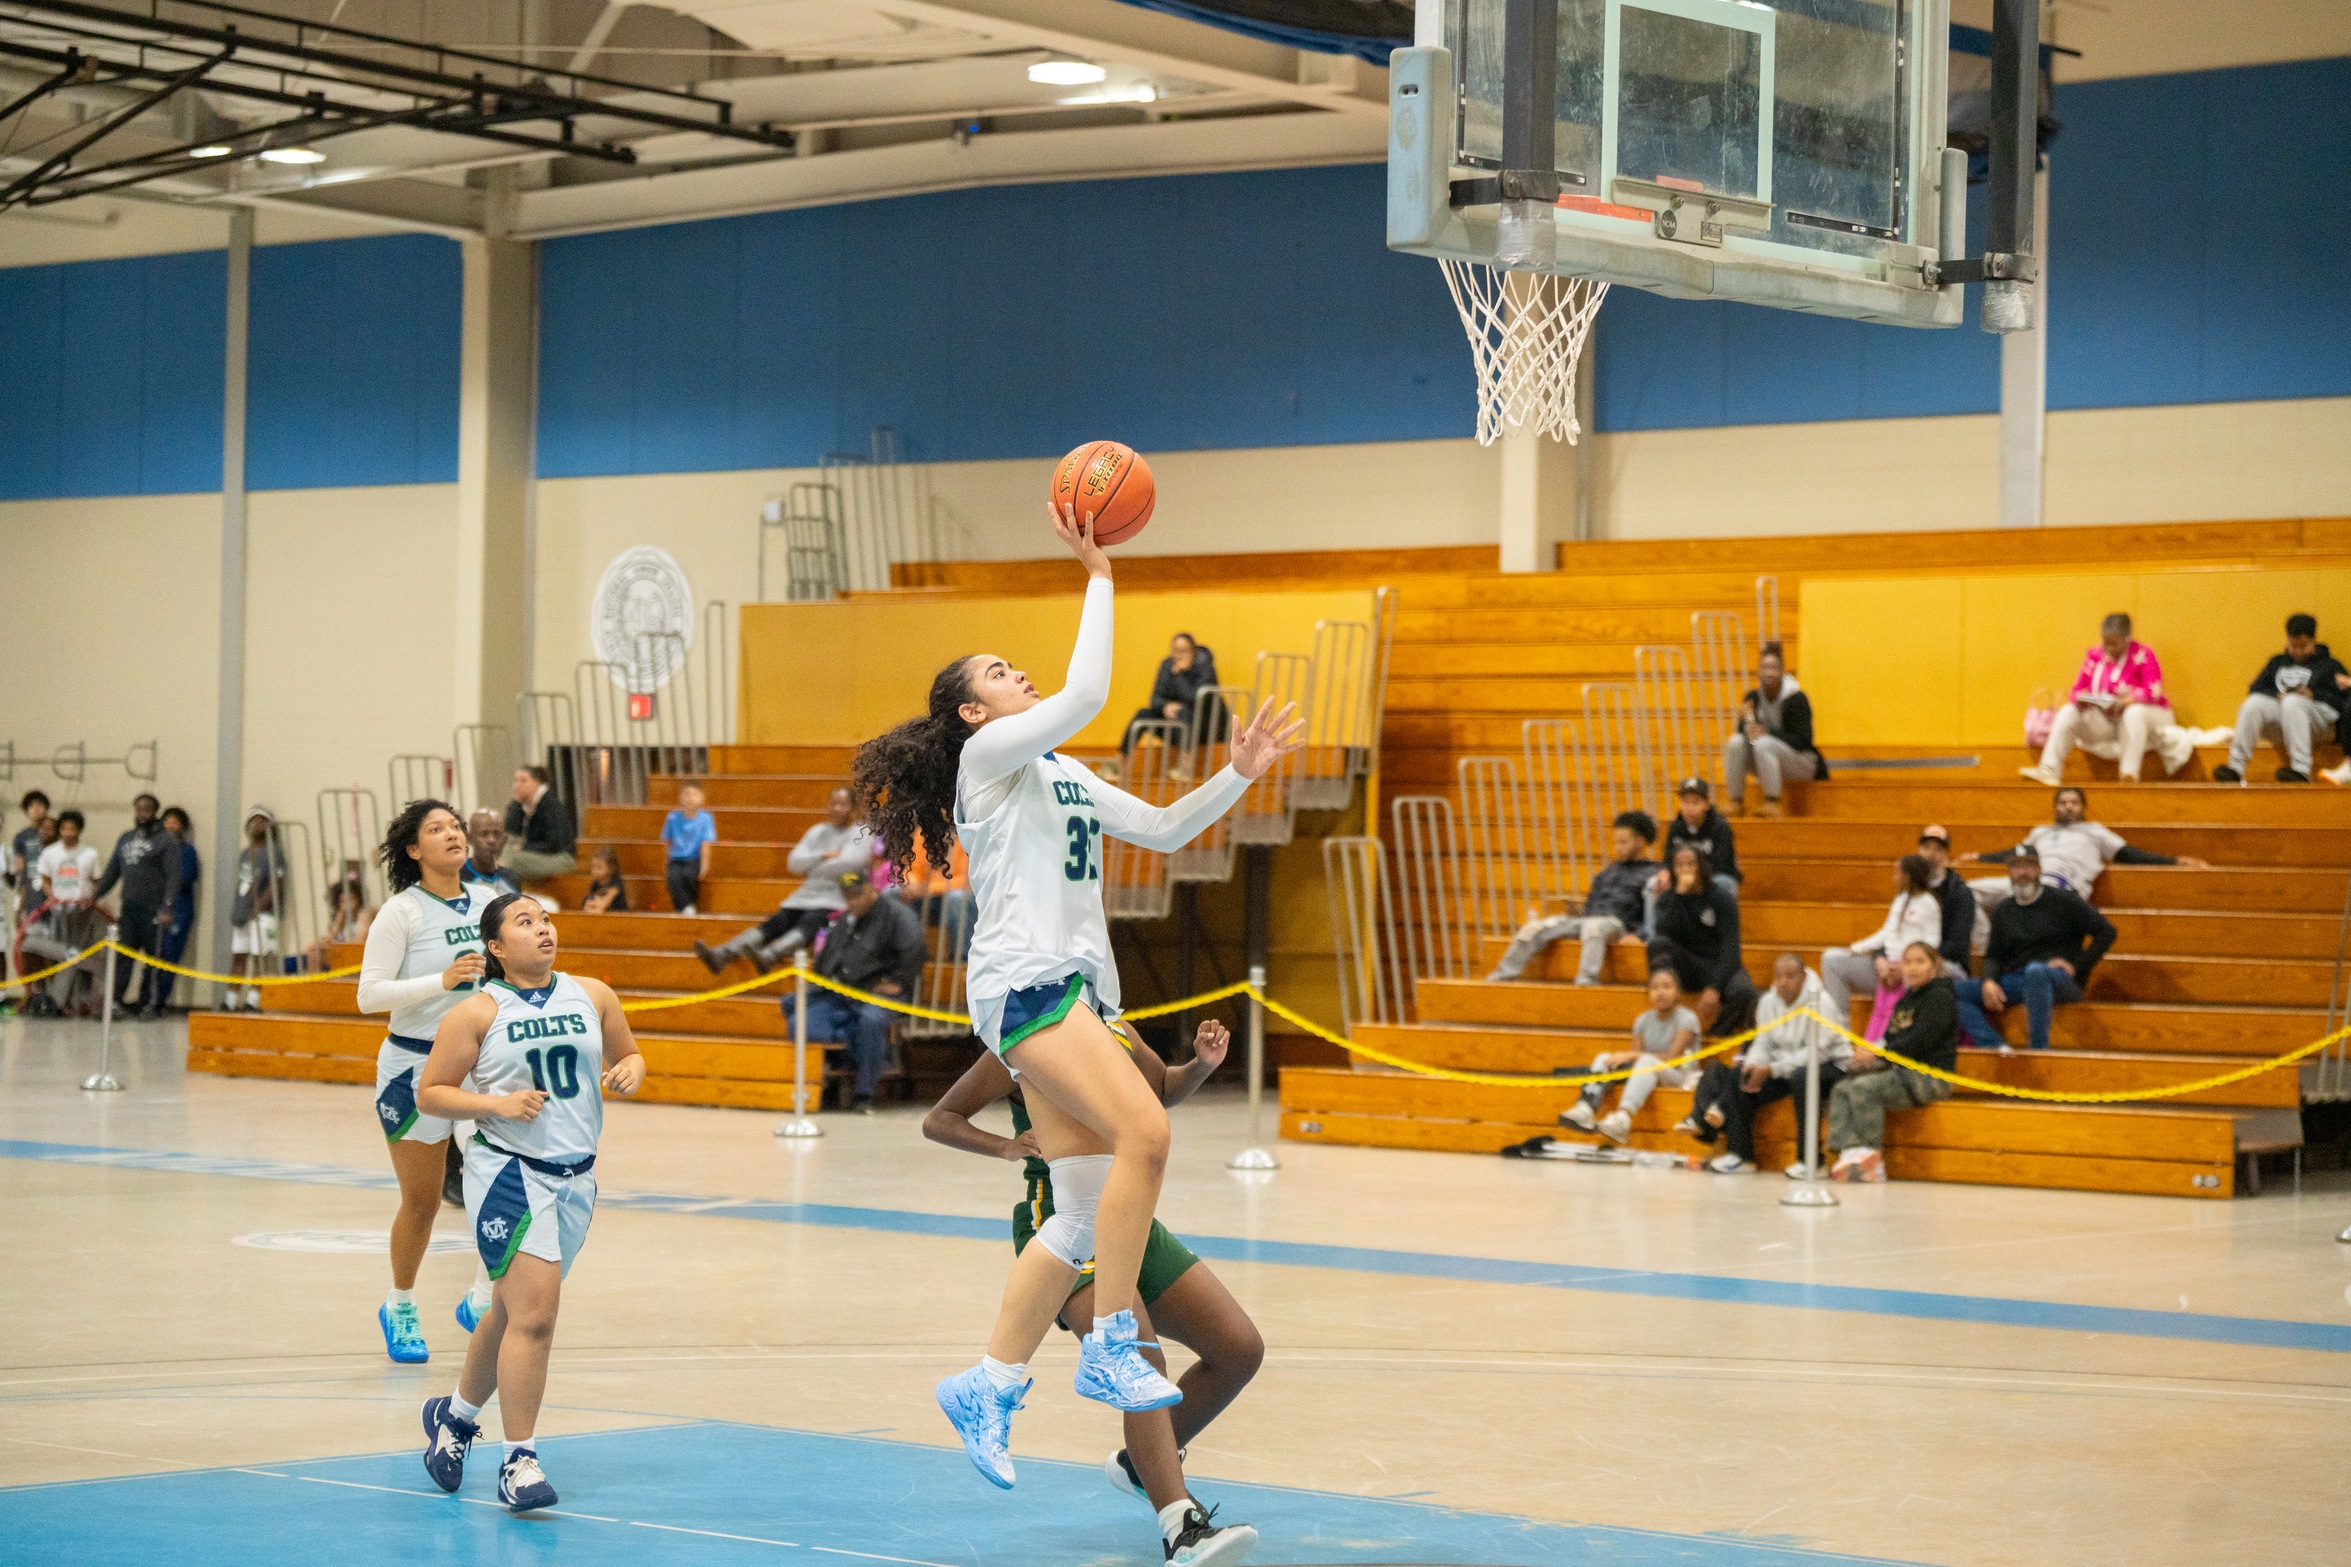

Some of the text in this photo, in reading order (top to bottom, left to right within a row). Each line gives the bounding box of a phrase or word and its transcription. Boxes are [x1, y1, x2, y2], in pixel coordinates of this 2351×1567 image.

[1083, 446, 1117, 497] LEGACY
[1052, 780, 1095, 807] COL
[444, 924, 480, 946] COL
[506, 1013, 587, 1043] COLTS
[525, 1044, 580, 1102] 10
